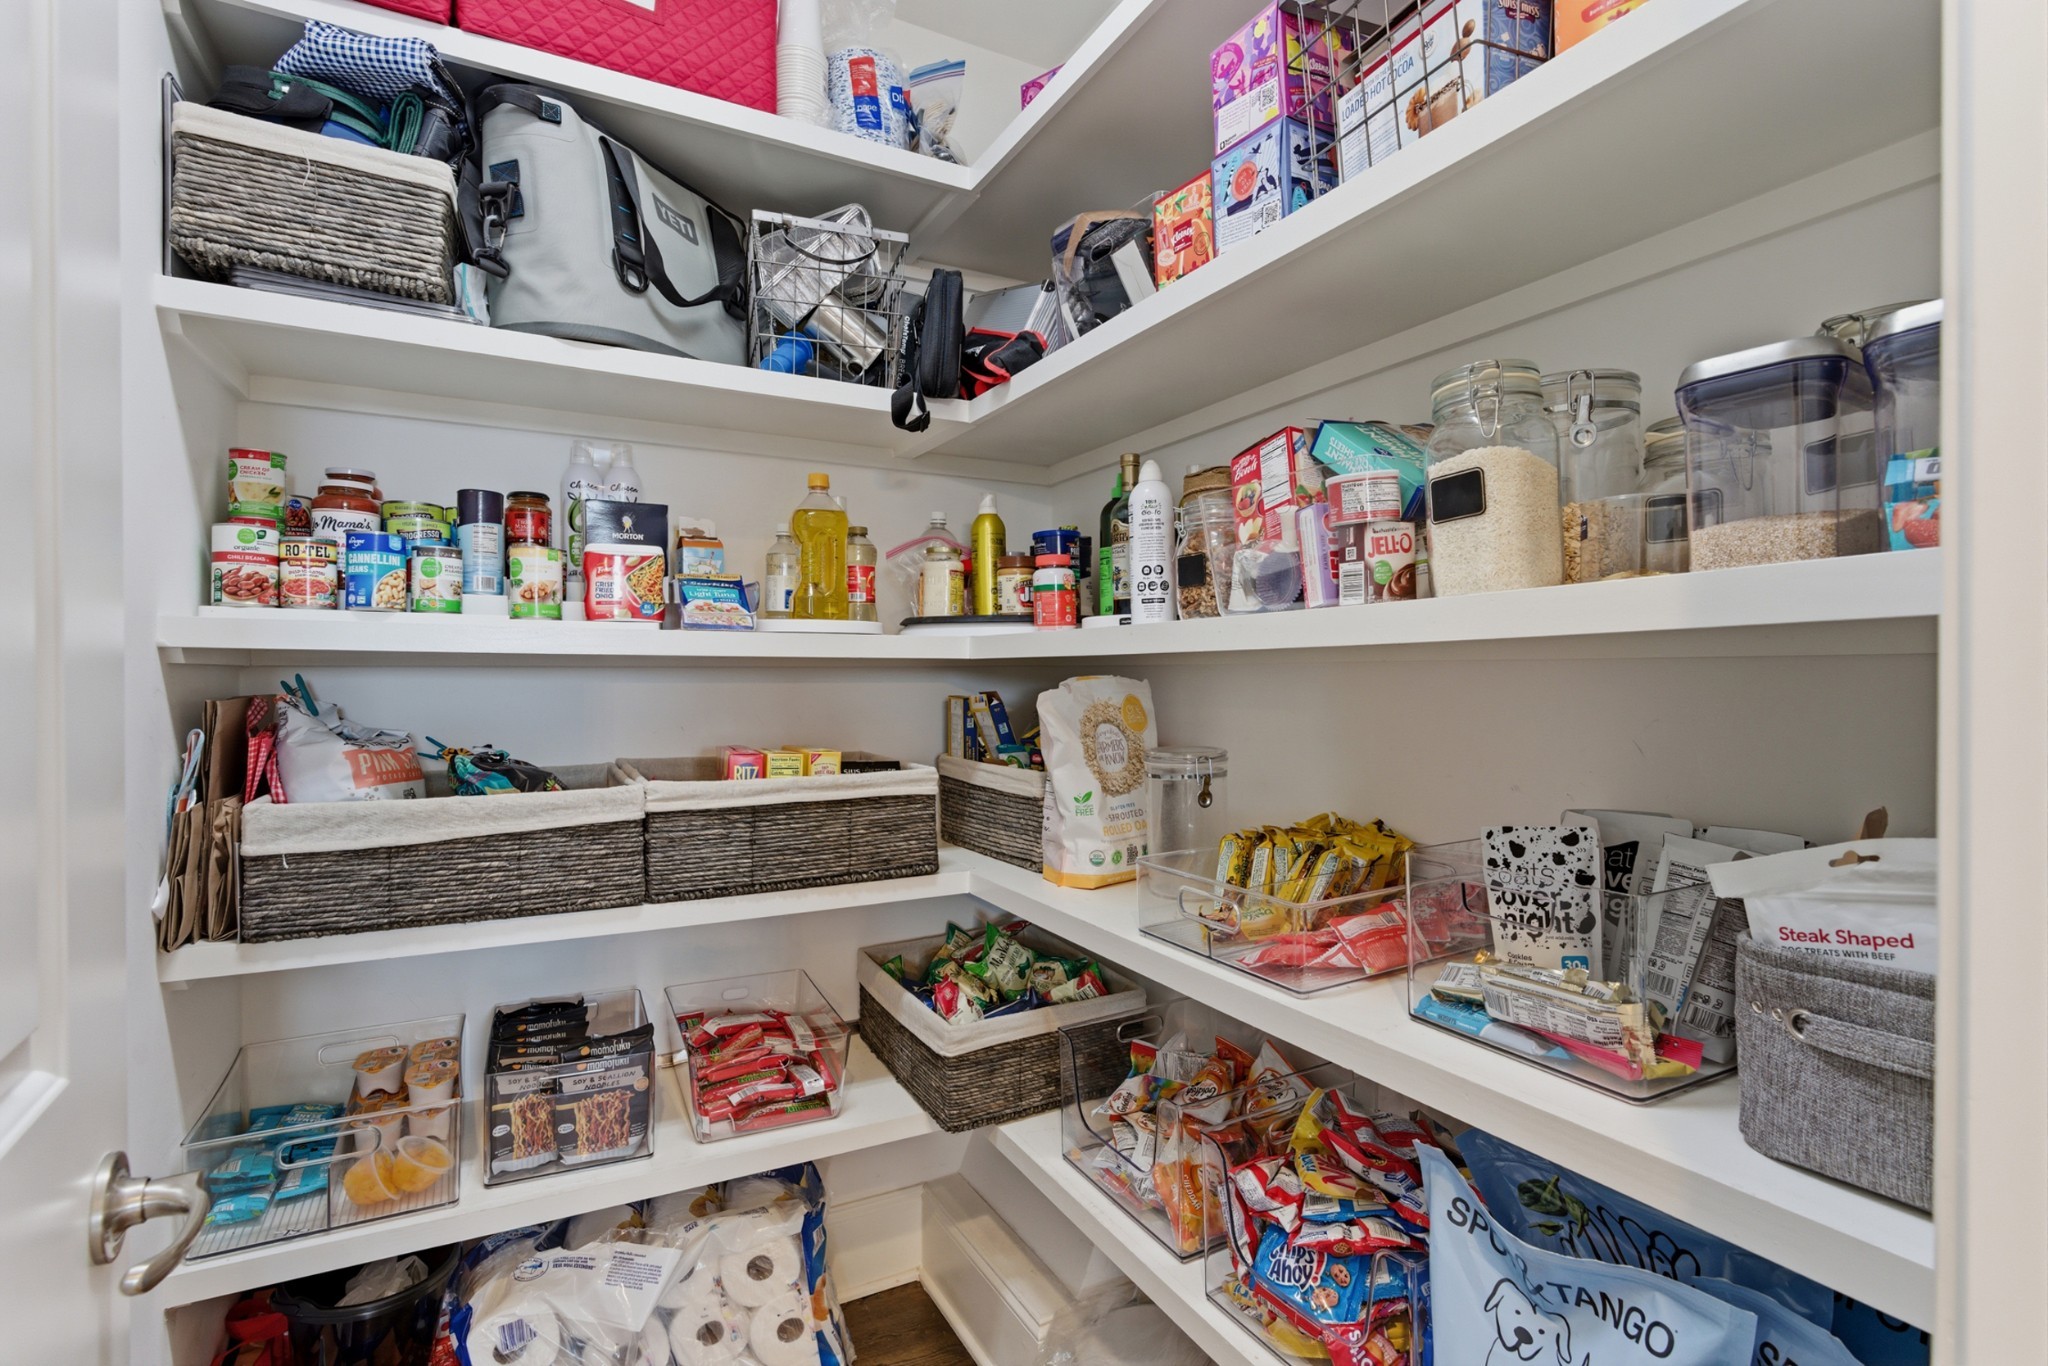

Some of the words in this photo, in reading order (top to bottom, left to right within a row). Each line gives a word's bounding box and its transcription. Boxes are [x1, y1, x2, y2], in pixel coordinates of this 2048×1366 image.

[1342, 91, 1369, 122] LOADED
[1370, 77, 1387, 99] HOT
[1387, 56, 1414, 86] COCOA
[656, 201, 694, 239] YETI
[320, 515, 372, 532] Mama's
[612, 532, 644, 541] MORTON
[1368, 532, 1412, 558] JELL-O
[348, 552, 400, 567] CANNELLINI
[348, 565, 369, 573] BEANS
[358, 753, 400, 776] PINK
[733, 765, 759, 780] RITZ
[1103, 822, 1133, 837] ROLLED
[1134, 819, 1149, 832] OA
[1779, 926, 1831, 944] Steak
[1836, 930, 1915, 951] Shaped
[1804, 947, 1840, 958] TREATS
[1843, 950, 1869, 960] WITH
[1872, 952, 1896, 962] BEEF
[590, 1038, 632, 1056] momofuku
[587, 1056, 630, 1070] momofuku
[573, 1077, 587, 1086] SOY
[597, 1070, 637, 1081] SCALLION
[584, 1080, 621, 1091] NOODLES
[1186, 1084, 1218, 1100] Goldfish
[1183, 1174, 1202, 1211] CHEDDAR
[1546, 1281, 1675, 1359] TANGO
